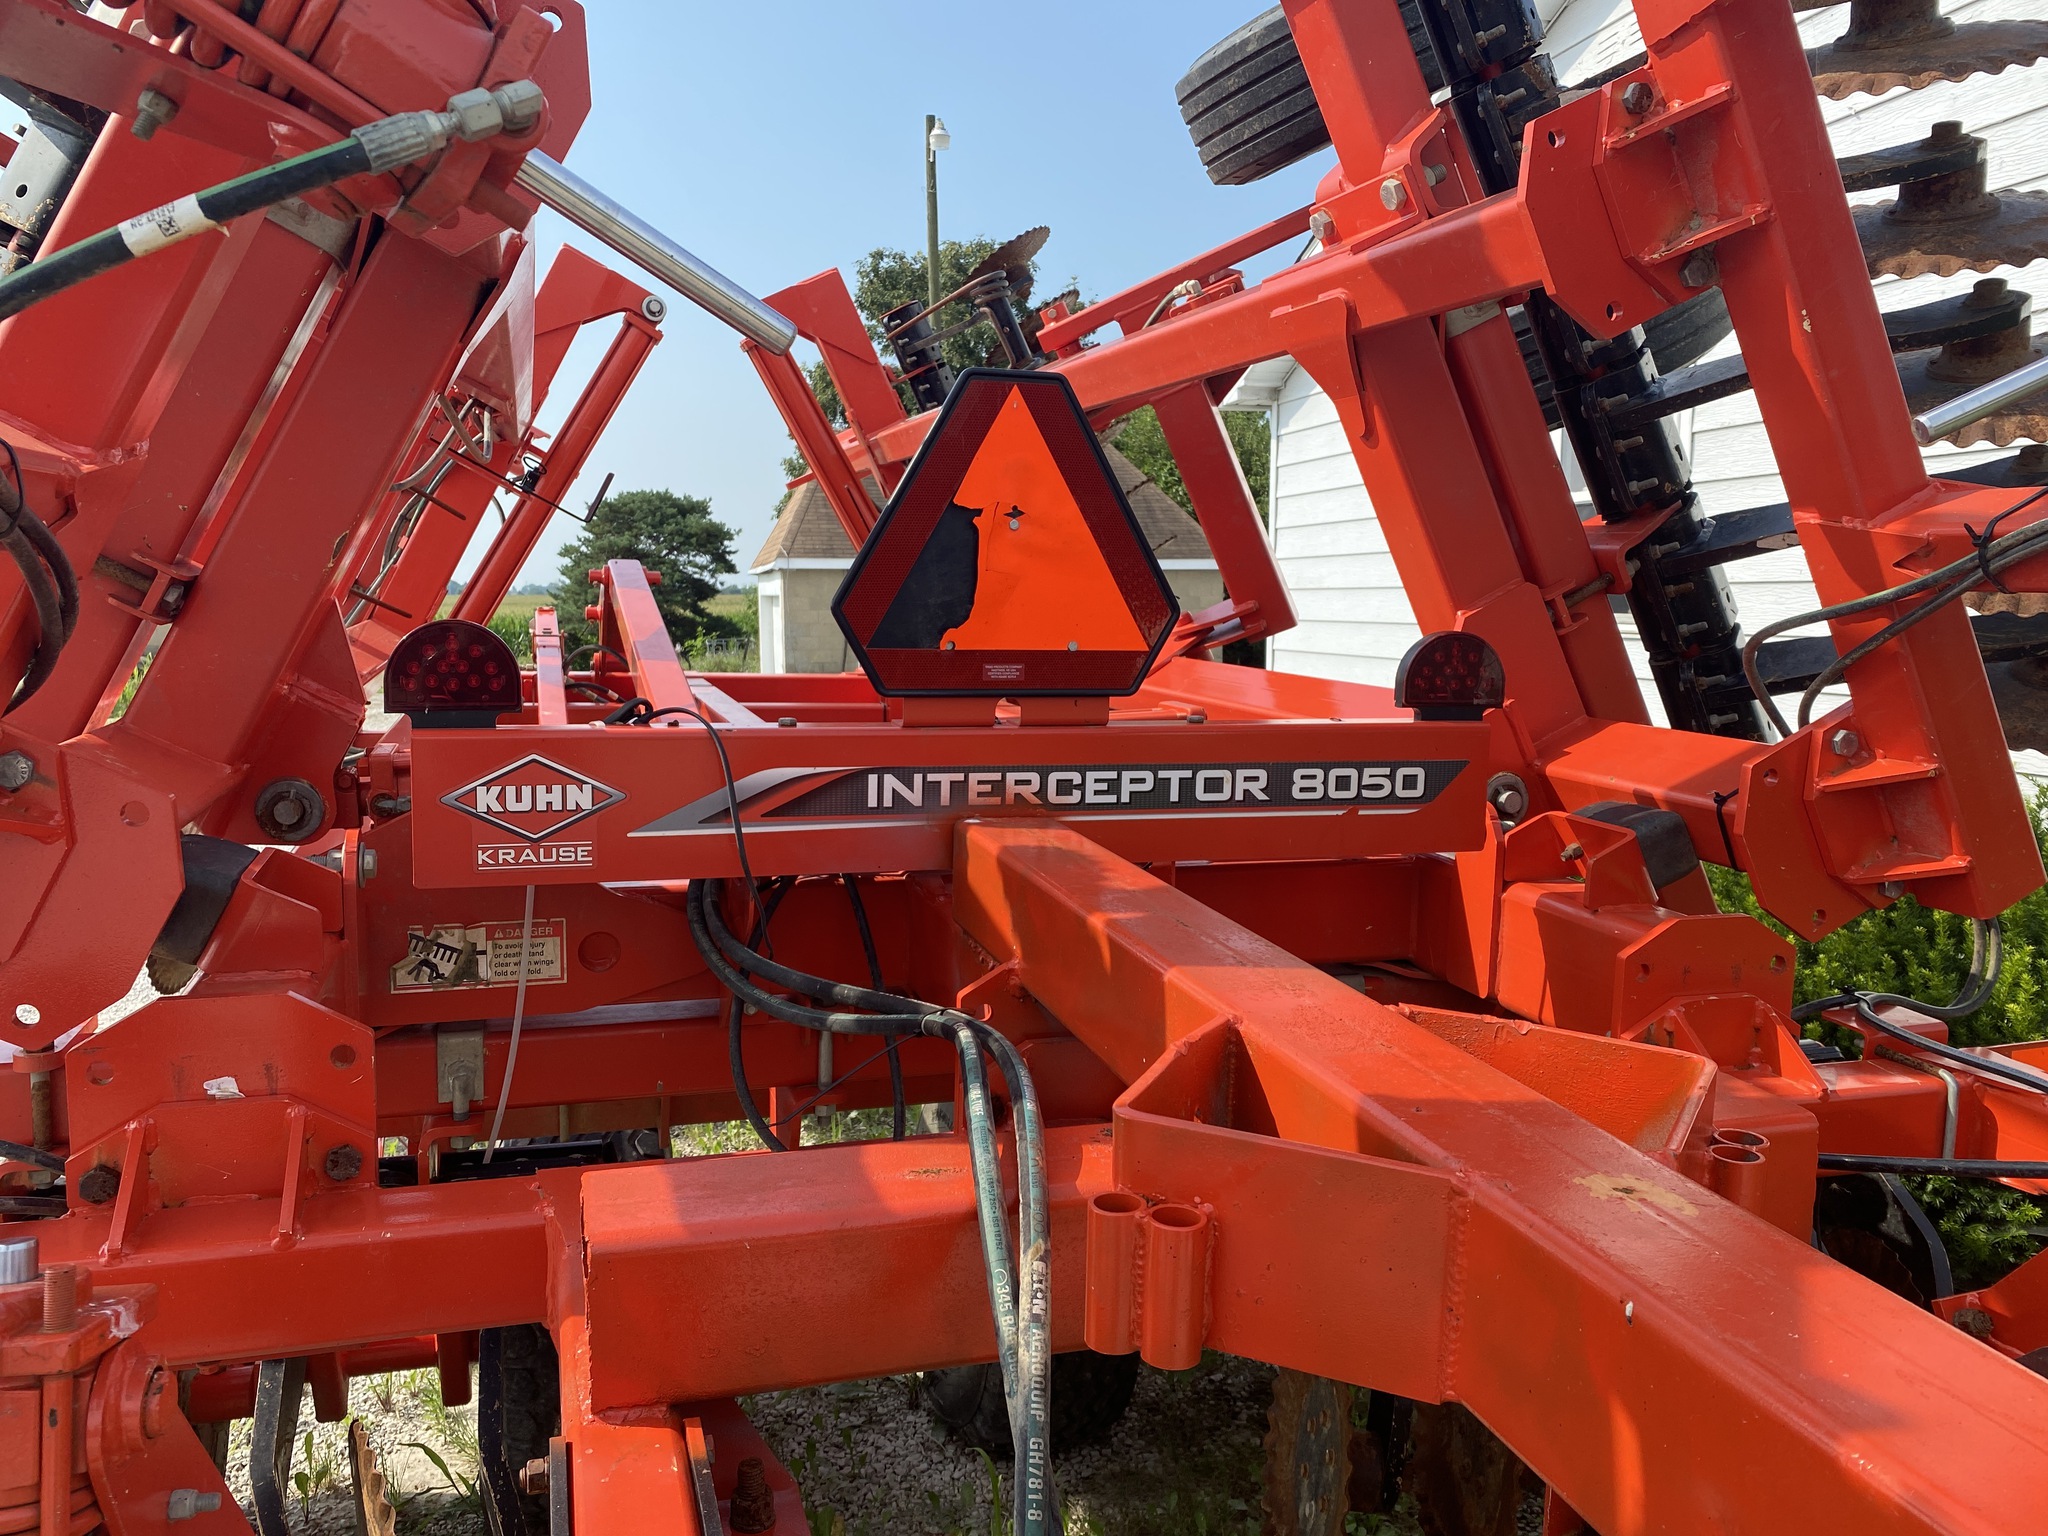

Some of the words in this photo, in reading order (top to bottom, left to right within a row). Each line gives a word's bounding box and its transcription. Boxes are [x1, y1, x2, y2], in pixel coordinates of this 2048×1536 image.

[475, 783, 593, 813] KUHN
[867, 769, 1270, 808] INTERCEPTOR
[1291, 766, 1426, 800] 8050
[477, 846, 593, 865] KRAUSE
[505, 927, 553, 938] DAGER
[533, 959, 554, 967] wings
[996, 1284, 1013, 1312] 345
[1027, 1437, 1044, 1521] GH781-8
